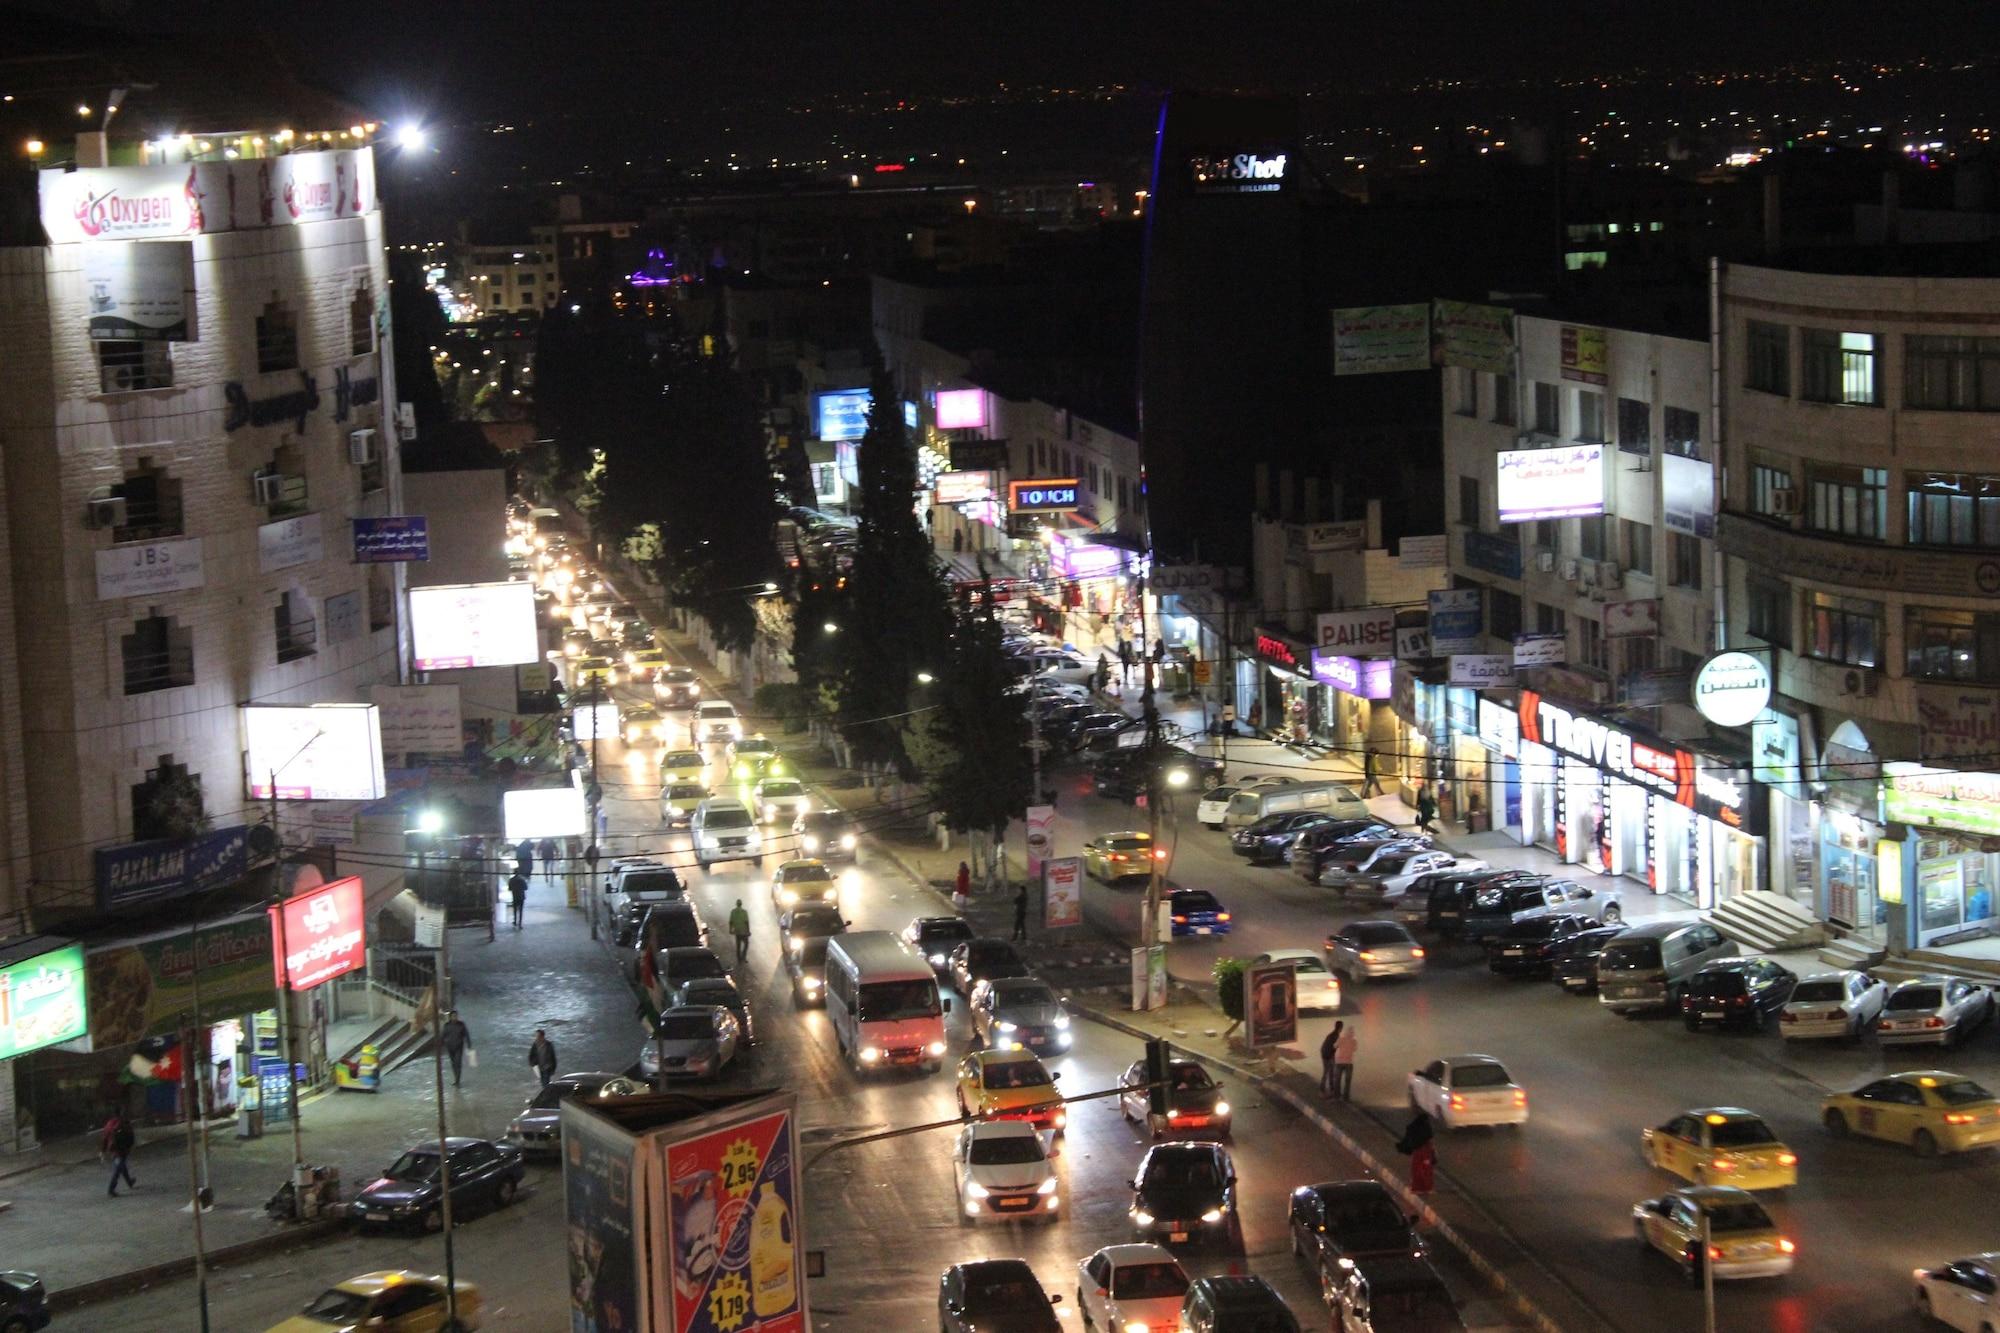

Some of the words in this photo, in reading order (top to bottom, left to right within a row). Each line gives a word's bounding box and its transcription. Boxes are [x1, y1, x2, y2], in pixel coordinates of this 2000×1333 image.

[1231, 154, 1287, 179] Shot
[110, 196, 172, 223] Oxygen
[1568, 448, 1600, 464] مركز
[1019, 489, 1075, 504] TOUCH
[134, 546, 171, 567] JBS
[1538, 701, 1634, 779] TRAVEL
[723, 1161, 756, 1189] 2.95
[715, 1295, 744, 1321] 1.79
